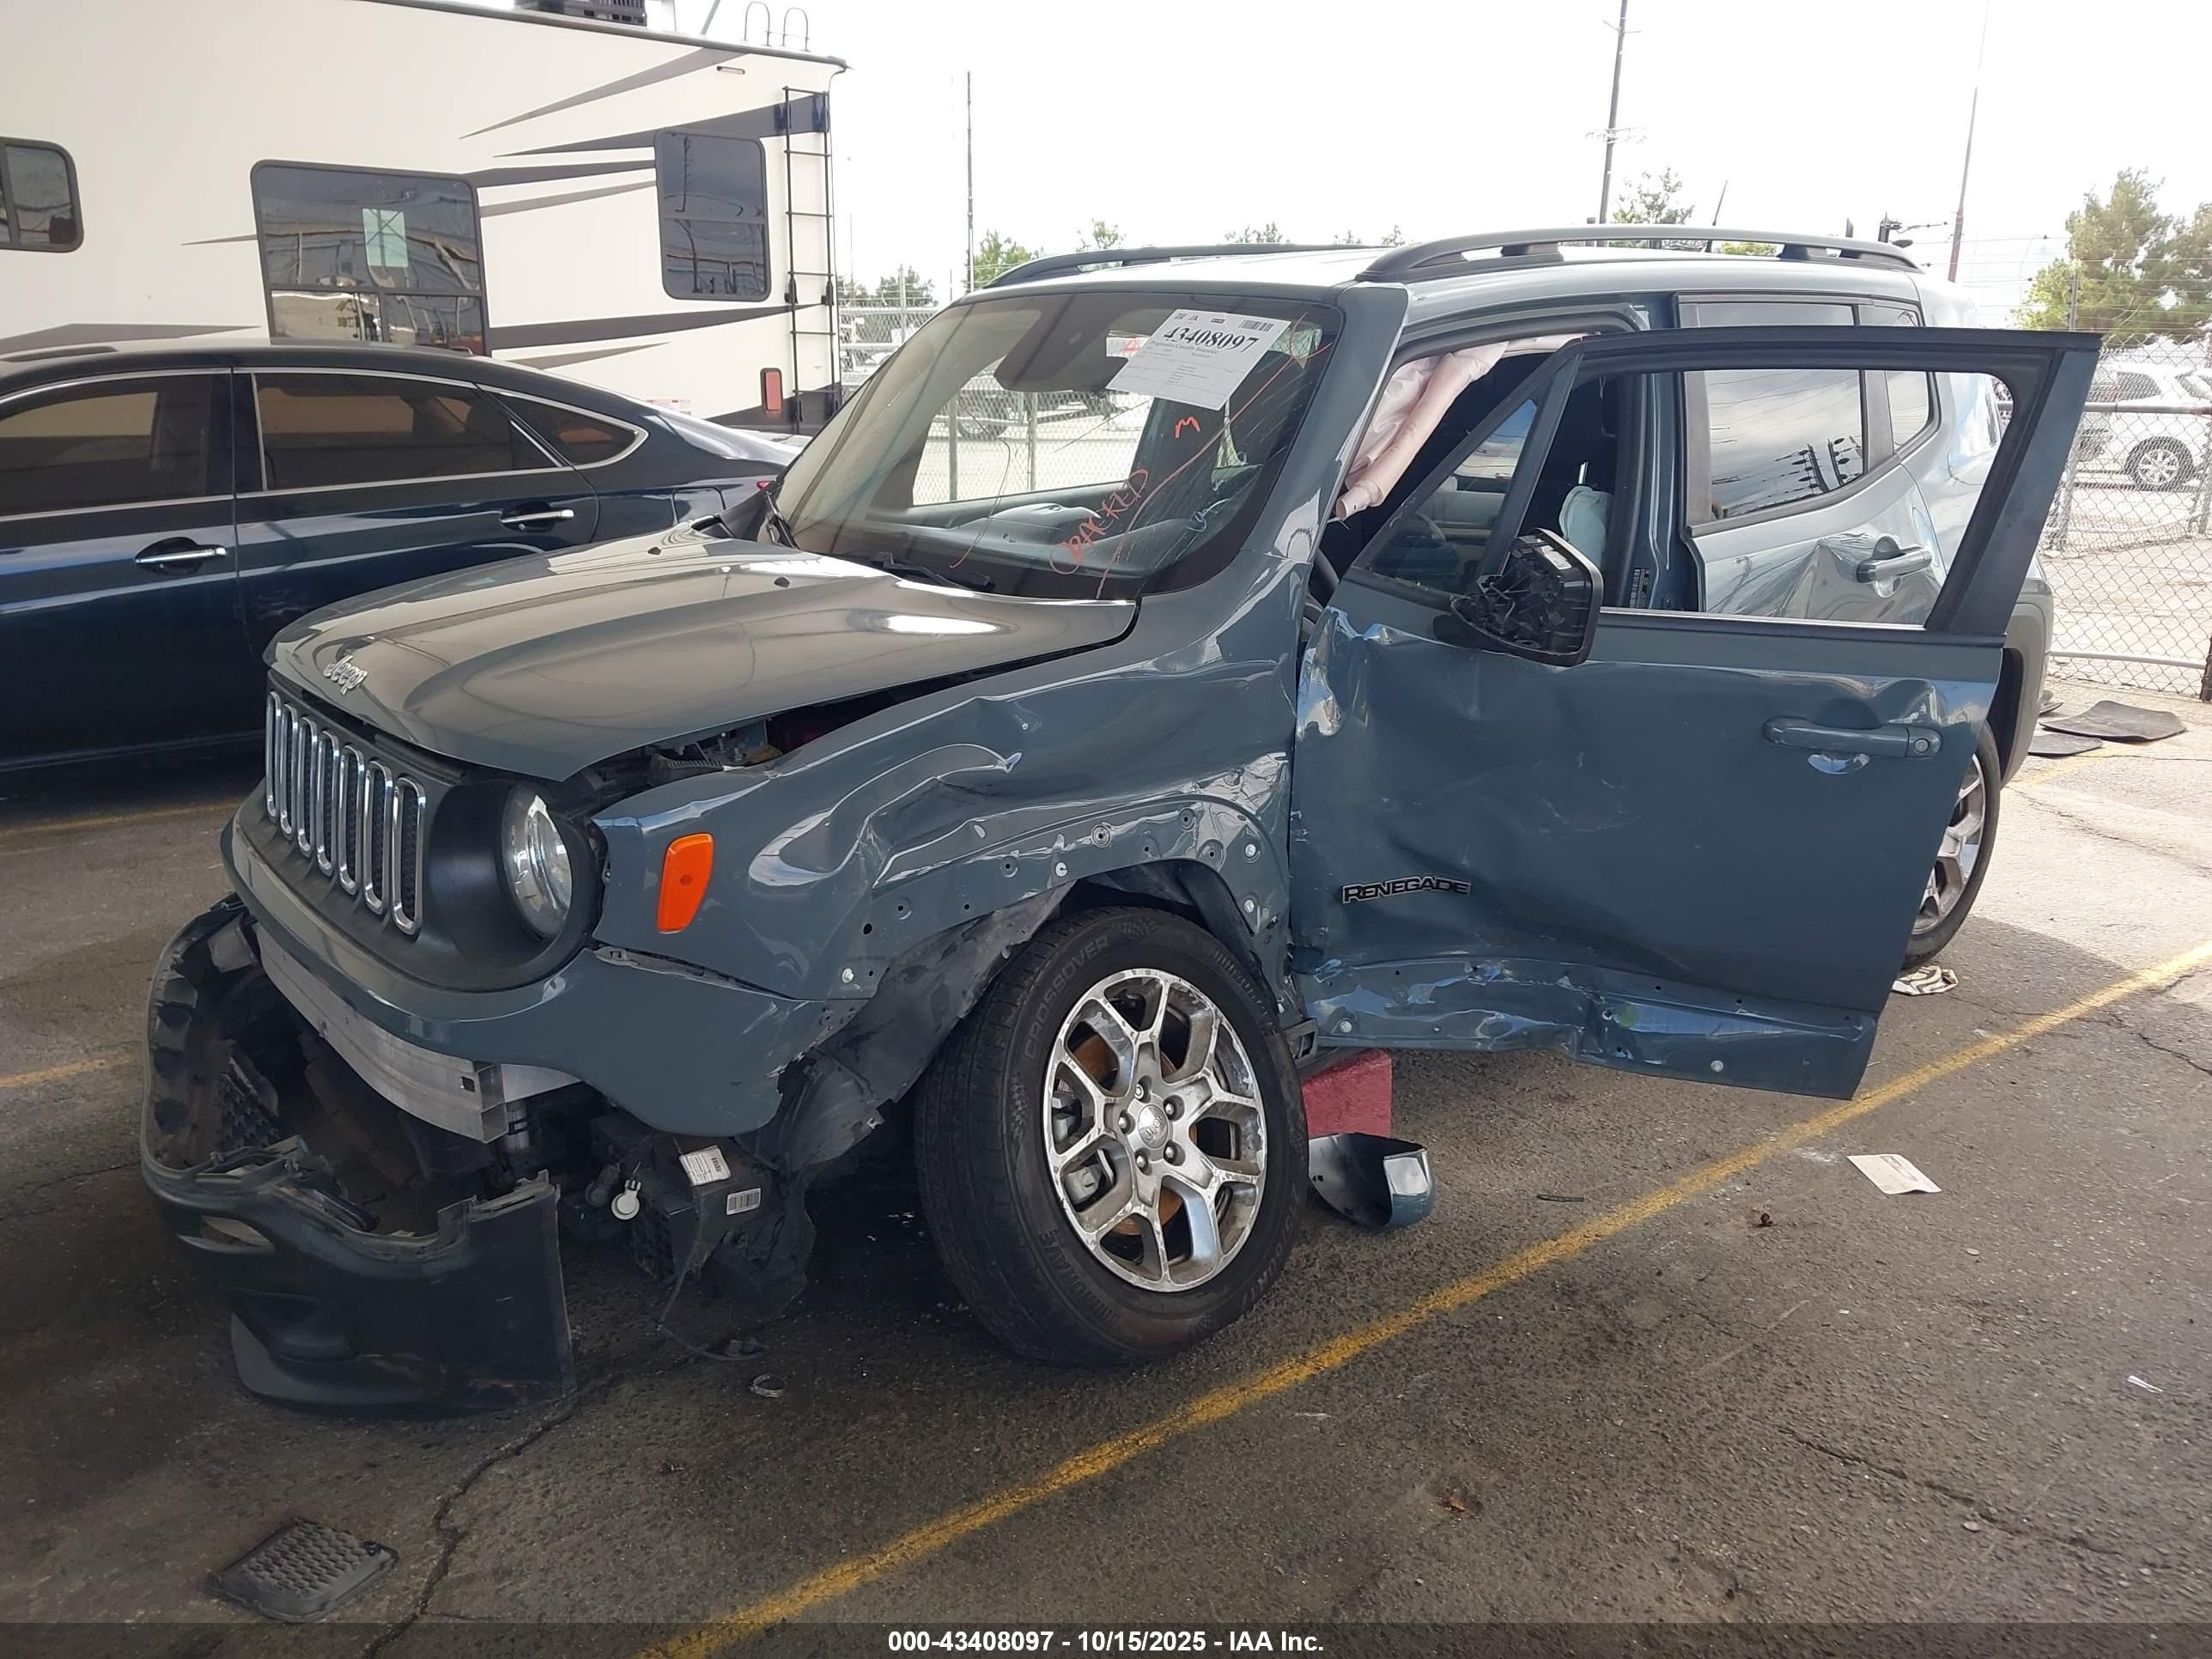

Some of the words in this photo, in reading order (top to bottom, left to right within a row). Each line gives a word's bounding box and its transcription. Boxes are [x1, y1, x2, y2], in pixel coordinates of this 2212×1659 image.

[1164, 325, 1260, 353] 43408097
[323, 653, 368, 695] Jeep
[1023, 933, 1110, 1061] CROSSOVER
[1146, 1115, 1164, 1140] Jeep
